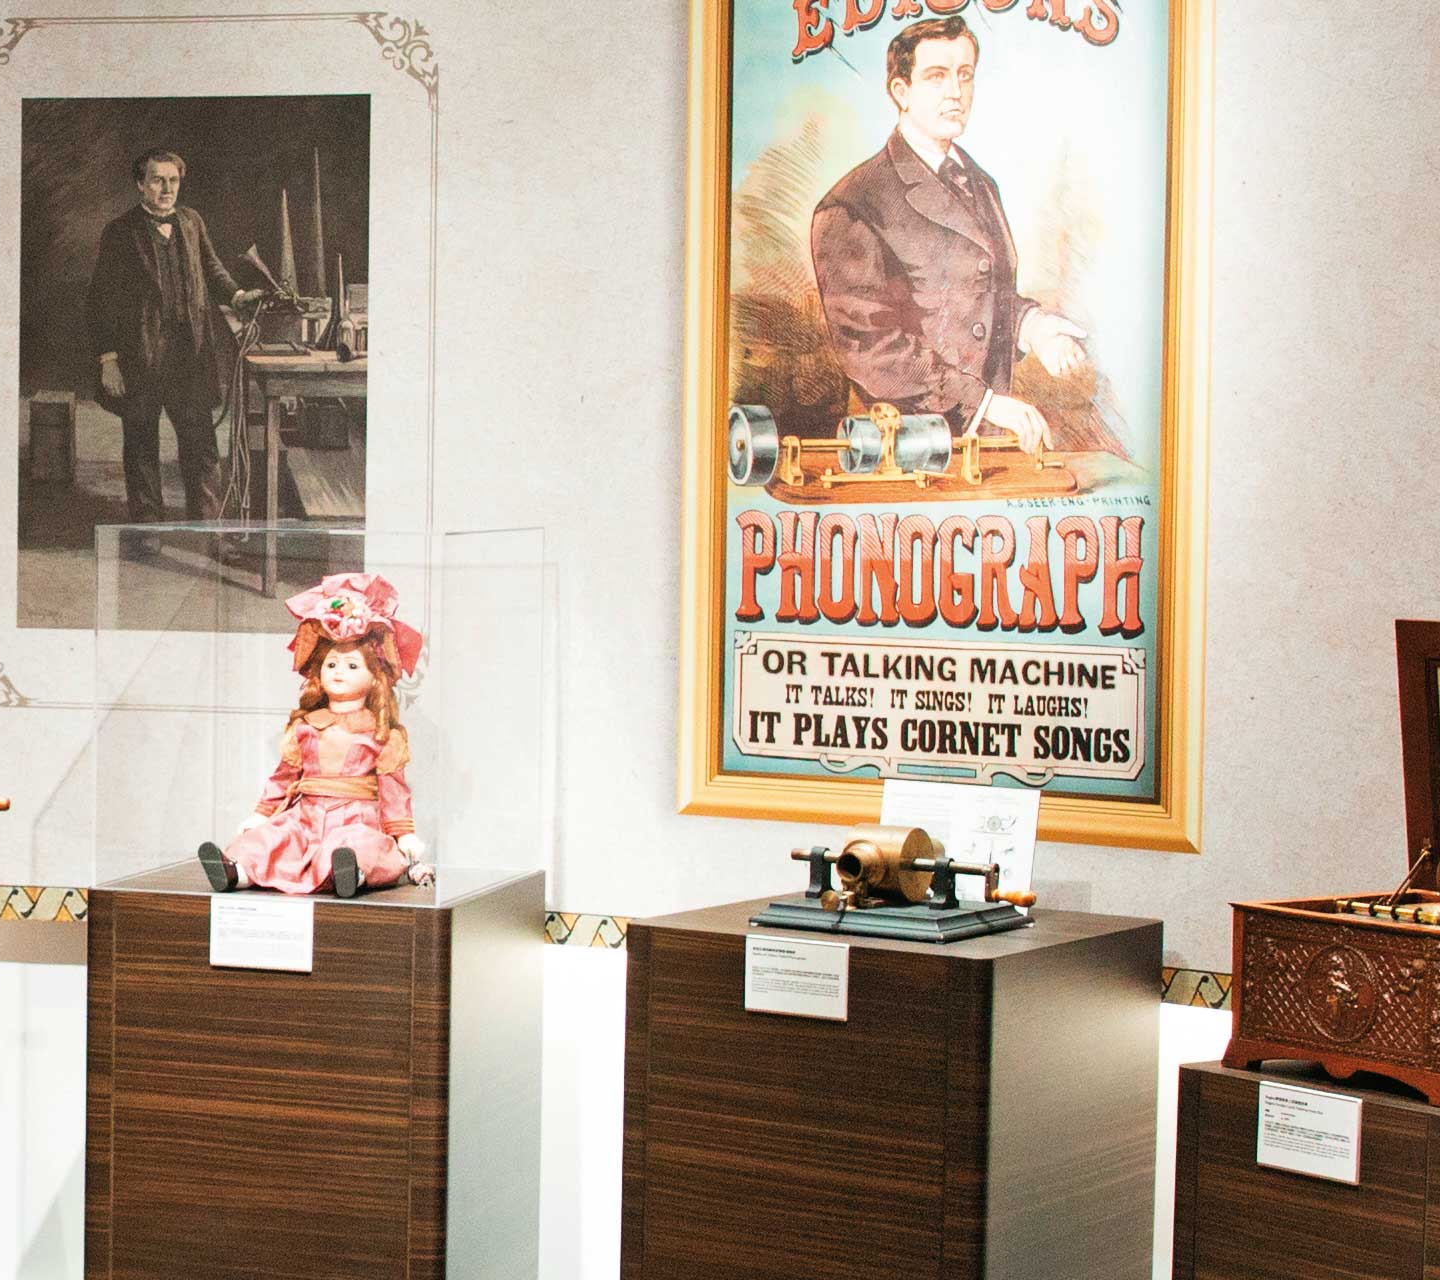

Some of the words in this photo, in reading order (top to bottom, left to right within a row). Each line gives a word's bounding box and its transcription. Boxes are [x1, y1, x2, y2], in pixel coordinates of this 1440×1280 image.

[735, 510, 1145, 639] PHONOGRAPH
[762, 650, 807, 675] OR
[821, 651, 957, 682] TALKING
[969, 657, 1117, 690] MACHINE
[785, 684, 803, 704] IT
[811, 685, 874, 708] TALKS!
[890, 689, 908, 709] IT
[915, 690, 972, 713] SINGS!
[987, 694, 1006, 714] IT
[1013, 695, 1088, 718] LAUGHS!
[748, 710, 781, 744] IT
[793, 712, 888, 750] PLAYS
[900, 718, 1022, 758] CORNET
[1033, 724, 1130, 764] SONGS
